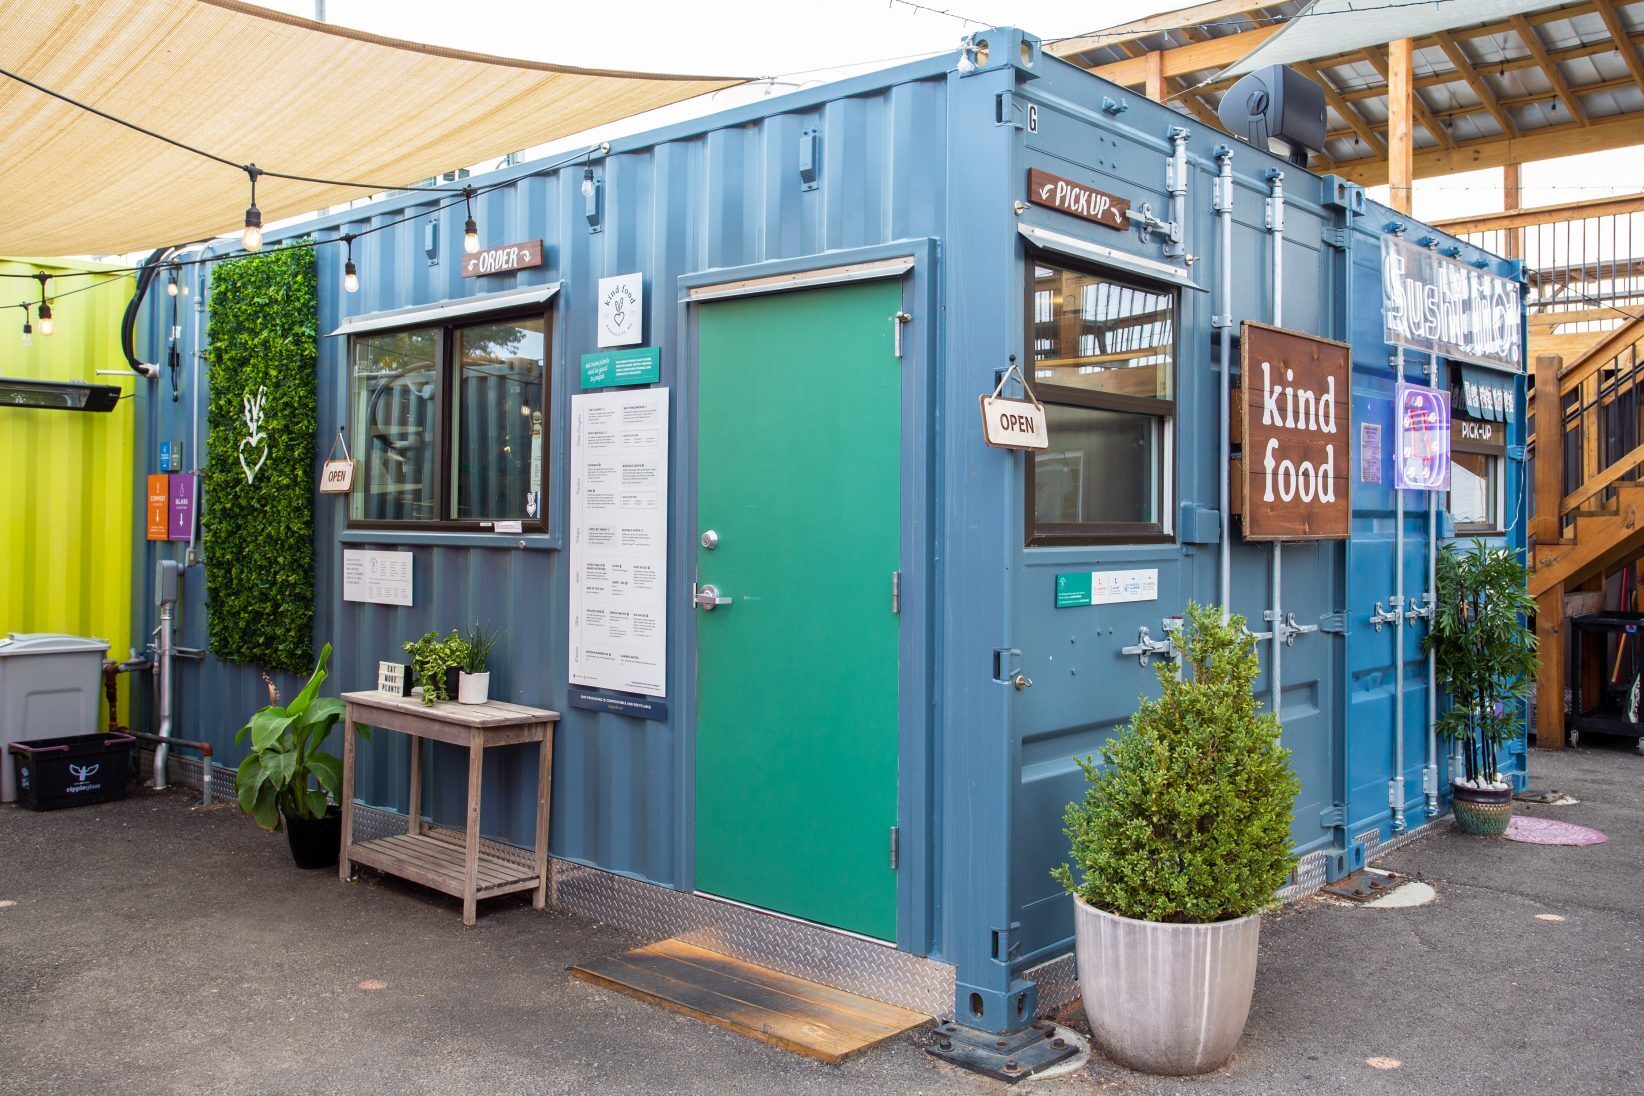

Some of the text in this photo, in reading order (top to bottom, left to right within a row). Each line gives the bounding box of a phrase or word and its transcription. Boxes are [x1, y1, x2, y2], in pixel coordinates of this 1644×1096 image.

[1029, 105, 1037, 132] G
[479, 247, 519, 272] ORDER
[604, 285, 636, 306] kind food
[1261, 362, 1337, 433] kind
[1000, 413, 1035, 433] OPEN
[1462, 422, 1492, 440] PICK-UP
[328, 471, 346, 482] OPEN
[1263, 438, 1336, 503] food
[384, 674, 397, 684] MORE
[387, 665, 396, 673] EAT
[381, 684, 400, 694] PLANTS
